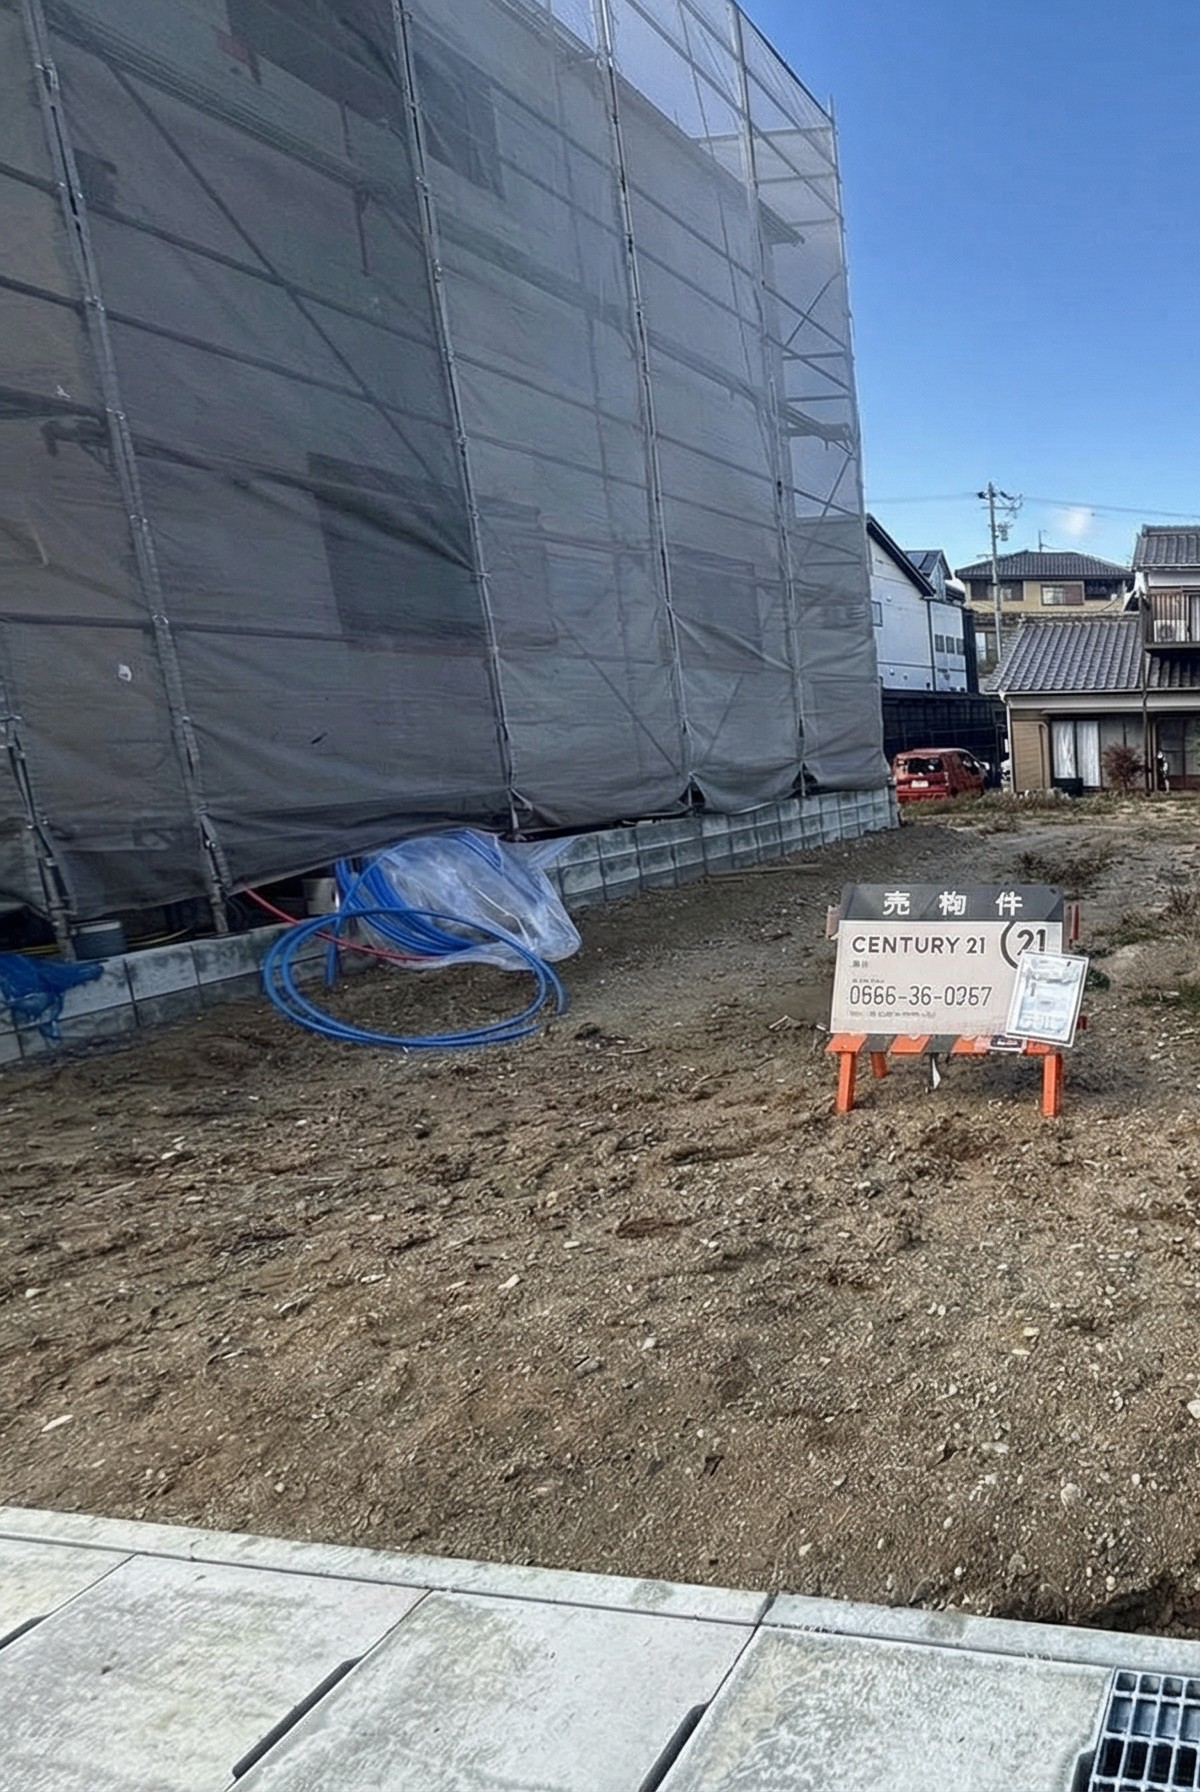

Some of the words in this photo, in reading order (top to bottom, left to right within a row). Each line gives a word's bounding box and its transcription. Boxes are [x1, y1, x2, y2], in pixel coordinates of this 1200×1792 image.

[852, 936, 960, 953] CENTURY
[966, 937, 985, 953] 21
[1016, 929, 1046, 956] 21
